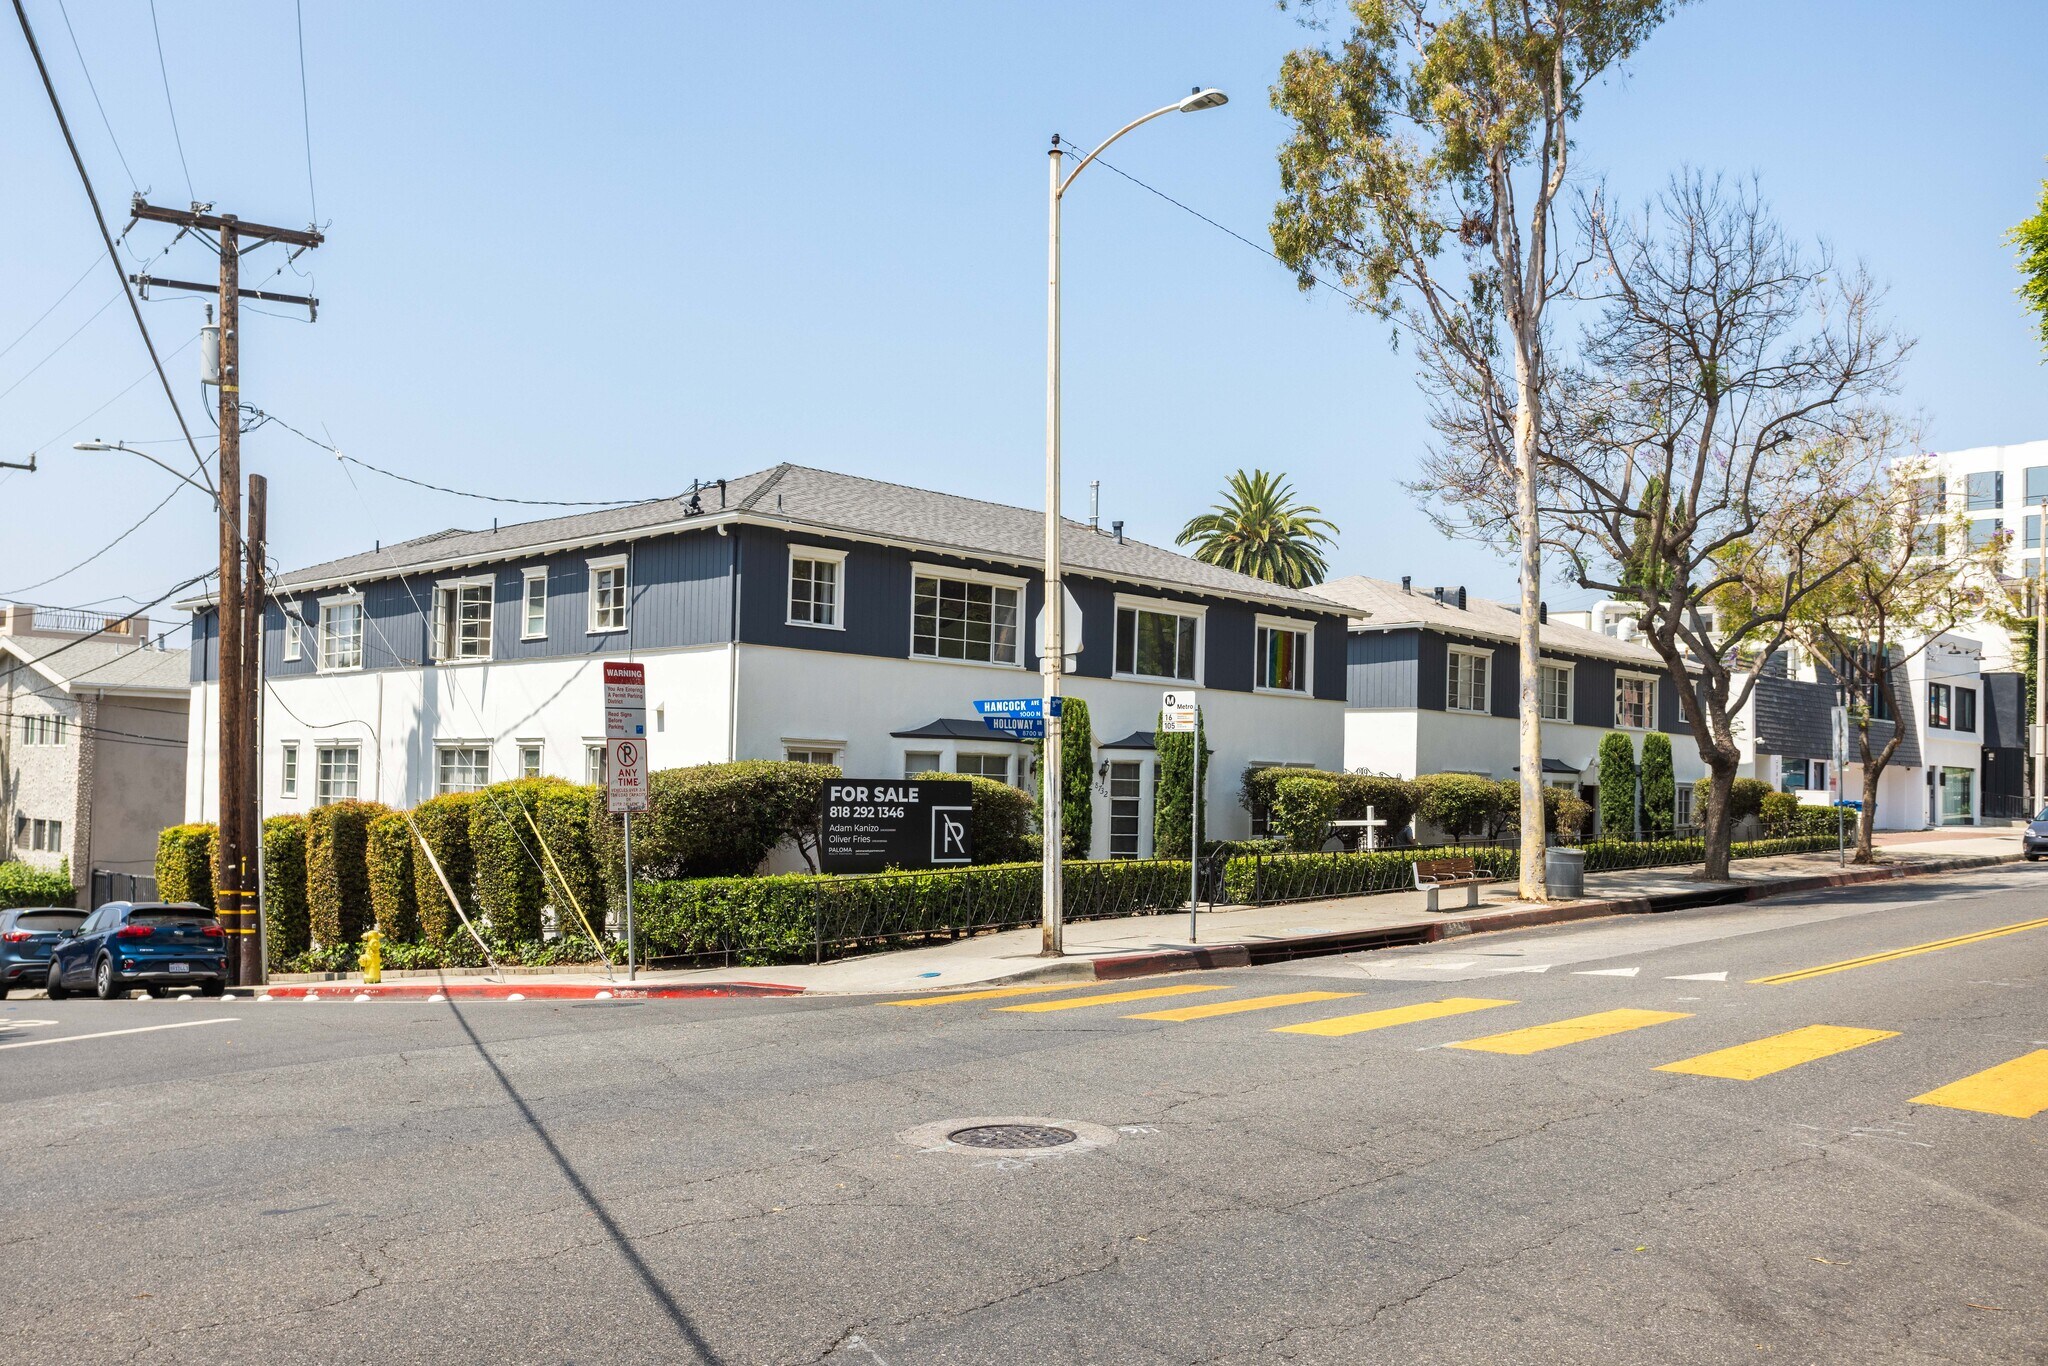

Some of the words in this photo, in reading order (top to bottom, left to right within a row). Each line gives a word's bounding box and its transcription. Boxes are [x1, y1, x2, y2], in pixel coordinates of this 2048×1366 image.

[606, 670, 642, 678] WARNING
[984, 700, 1026, 712] HANCOCK
[1166, 696, 1175, 705] M
[994, 719, 1033, 729] HOLLOWAY
[618, 778, 638, 786] TIME
[830, 786, 868, 802] FOR
[874, 787, 919, 802] SALE
[1095, 782, 1108, 797] 8732
[830, 806, 850, 818] 818
[853, 806, 874, 818] 292
[877, 807, 904, 818] 1346
